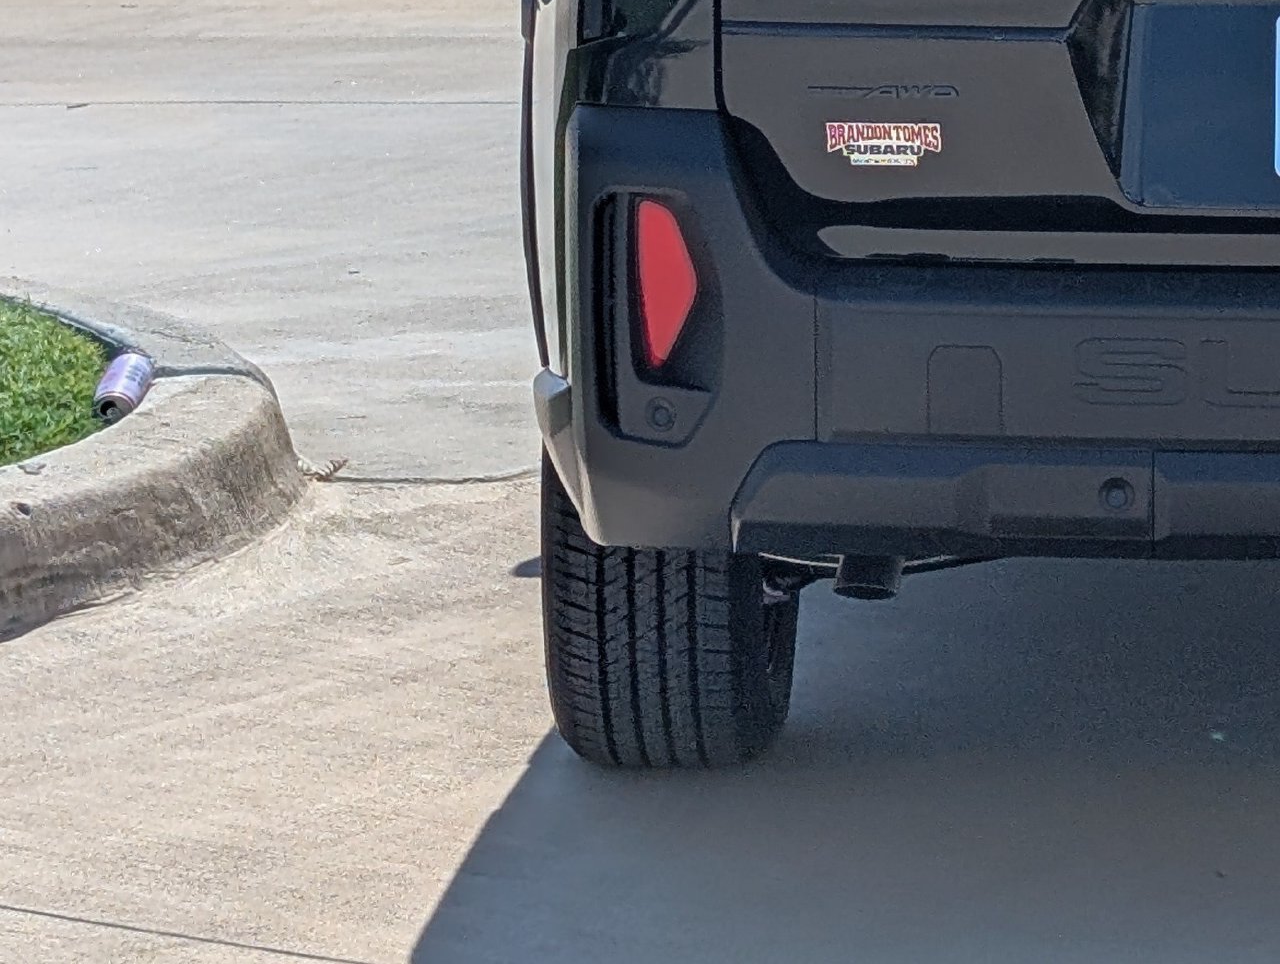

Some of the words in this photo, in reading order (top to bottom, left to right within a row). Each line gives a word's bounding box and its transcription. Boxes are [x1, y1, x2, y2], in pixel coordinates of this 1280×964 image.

[828, 124, 893, 150] BRANDON
[892, 125, 939, 150] TOMES
[846, 145, 922, 156] SUBARU
